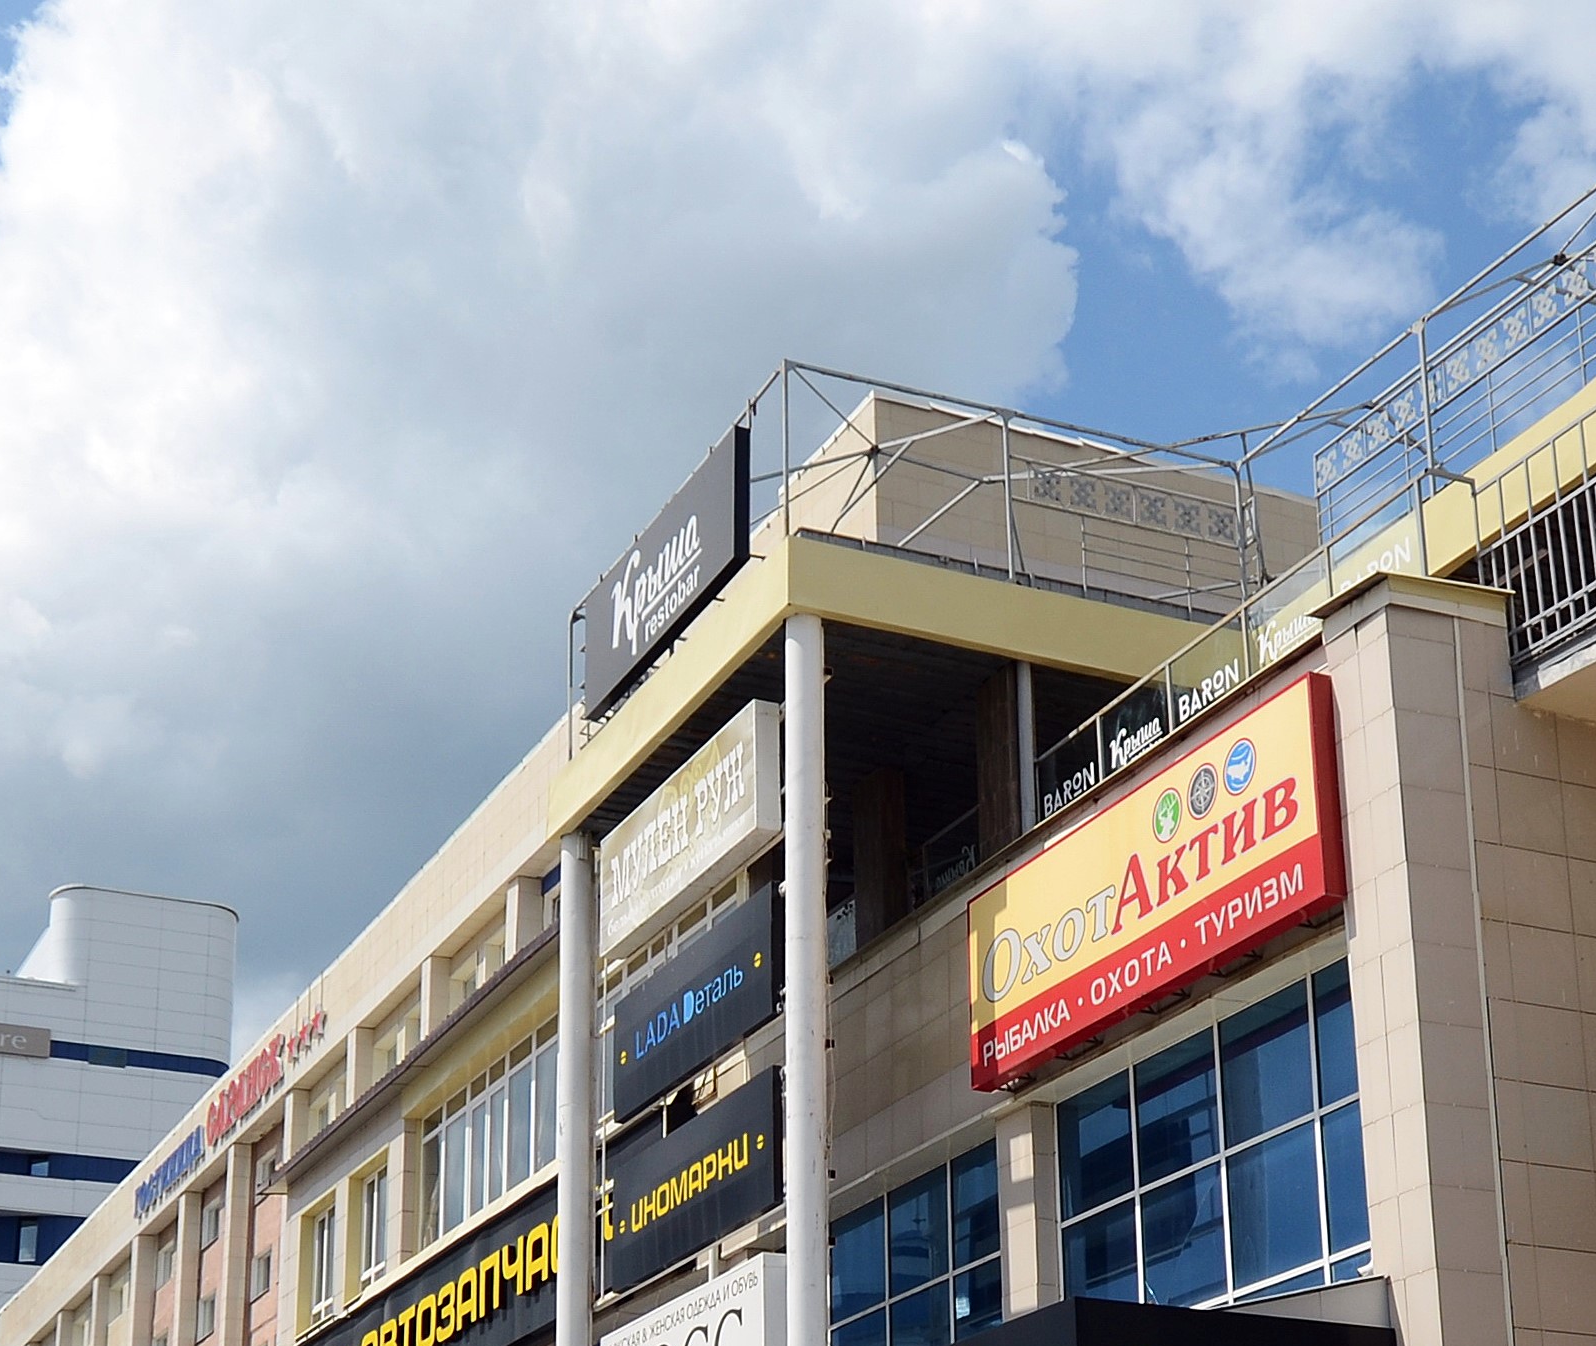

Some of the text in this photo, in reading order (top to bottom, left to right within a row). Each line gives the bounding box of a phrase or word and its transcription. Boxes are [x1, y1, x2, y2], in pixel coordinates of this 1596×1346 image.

[611, 514, 702, 656] Крыша
[644, 565, 701, 642] restobar
[1178, 658, 1240, 722] BARON
[1109, 717, 1164, 769] Крыша
[1043, 761, 1096, 818] BARON
[610, 793, 689, 912] МУЛЕН
[693, 741, 745, 838] РУЖ
[983, 863, 1304, 1068] РЫБАЛКА ОХОТА ТУРИЗМ
[634, 1002, 681, 1060] LADA
[686, 1289, 722, 1321] ОДЕЖДА
[731, 1273, 759, 1297] ОБУВЬ
